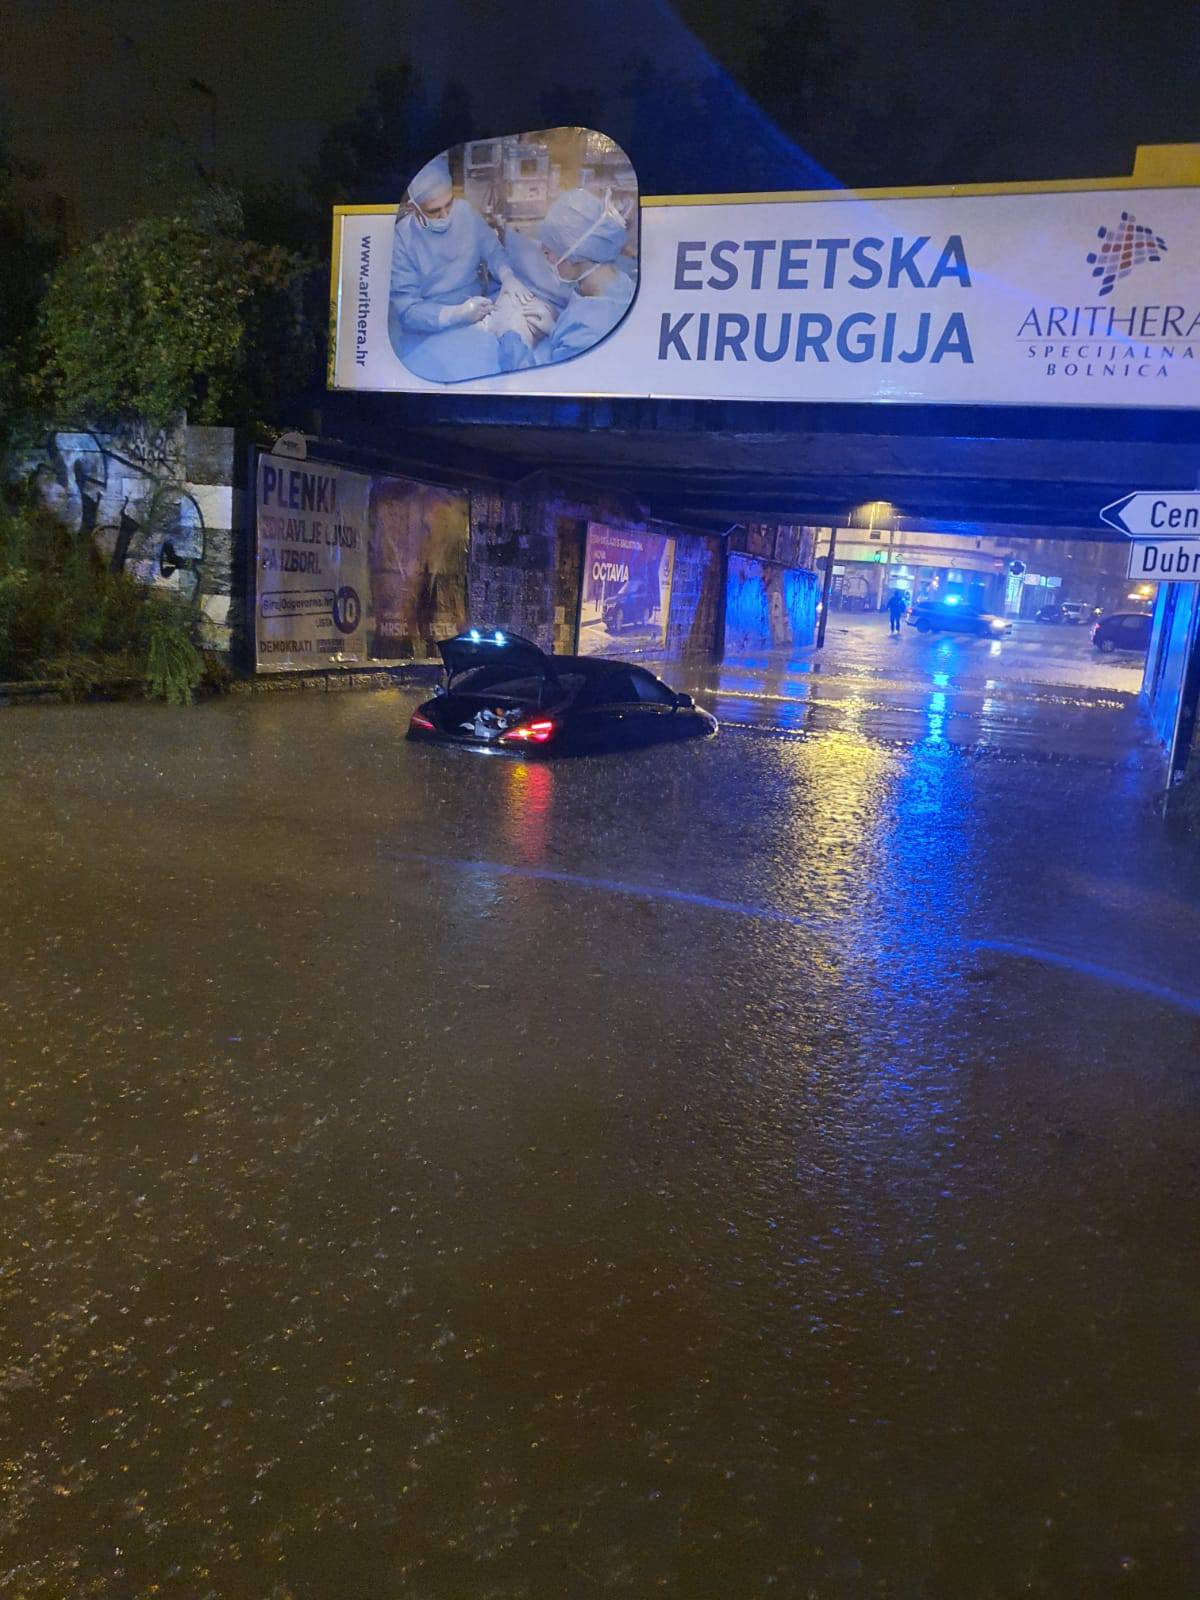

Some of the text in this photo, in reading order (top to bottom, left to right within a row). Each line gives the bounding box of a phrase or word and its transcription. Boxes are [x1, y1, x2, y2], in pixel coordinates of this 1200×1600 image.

[674, 235, 972, 290] ESTETSKA
[356, 235, 371, 367] www.arithera.hr
[657, 312, 975, 363] KIRURGIJA
[1028, 345, 1194, 360] SPECIJALNA
[1046, 363, 1168, 377] BOLNICA
[1150, 500, 1199, 528] Cen
[592, 562, 629, 582] OCTAVIA
[338, 597, 357, 623] 10
[260, 640, 312, 653] DEMOKRATI
